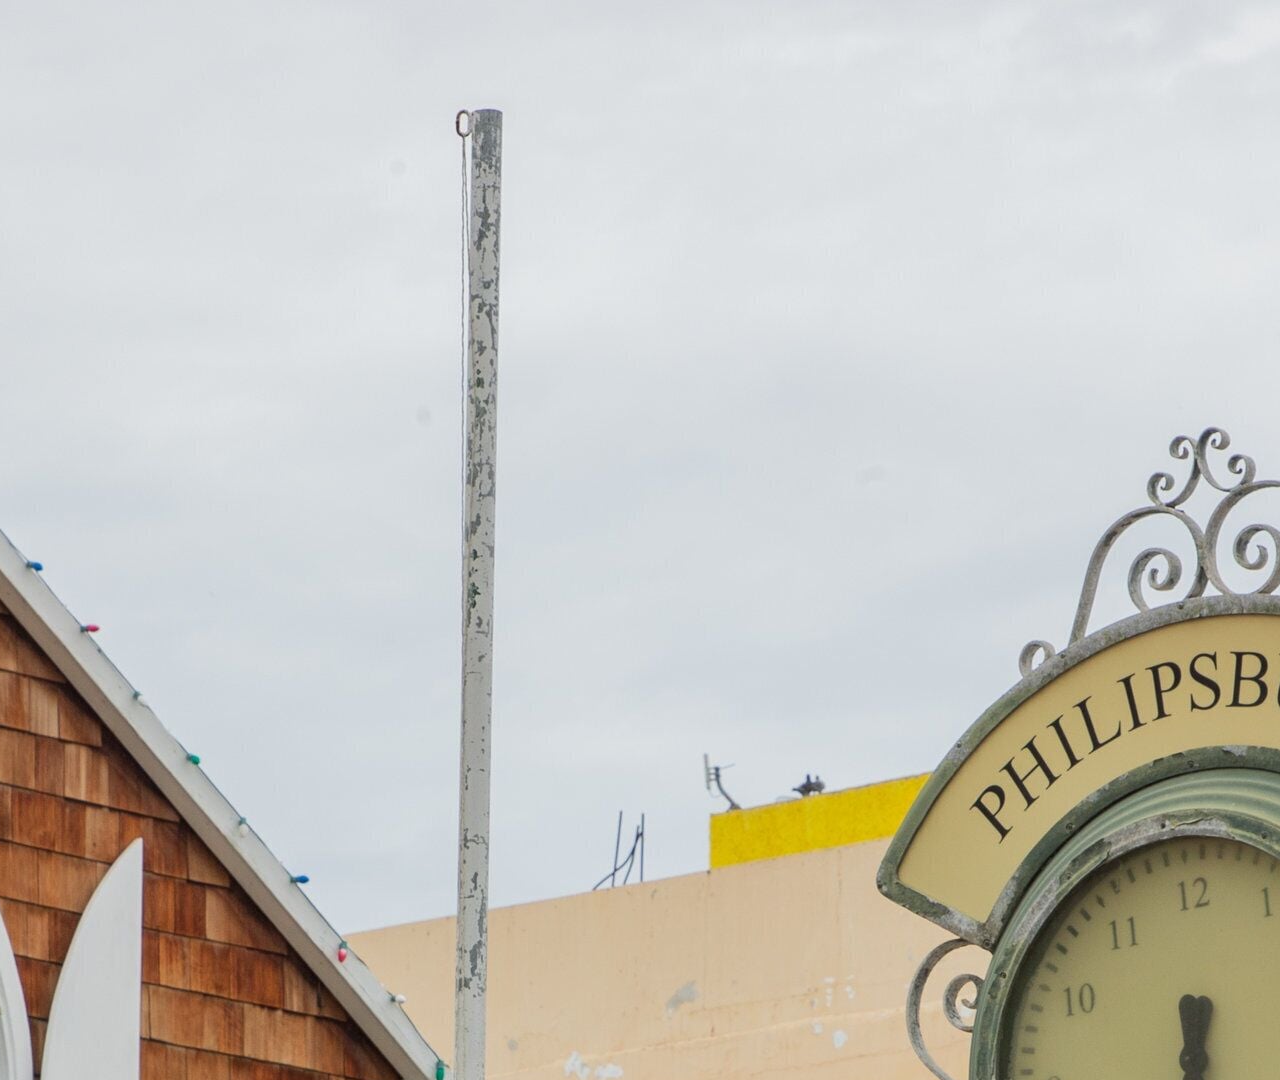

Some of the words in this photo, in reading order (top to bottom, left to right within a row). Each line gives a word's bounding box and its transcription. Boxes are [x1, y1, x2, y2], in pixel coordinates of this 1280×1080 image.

[1177, 876, 1212, 913] 12
[1259, 887, 1274, 918] 1
[1108, 916, 1141, 951] 11
[1062, 982, 1096, 1017] 10
